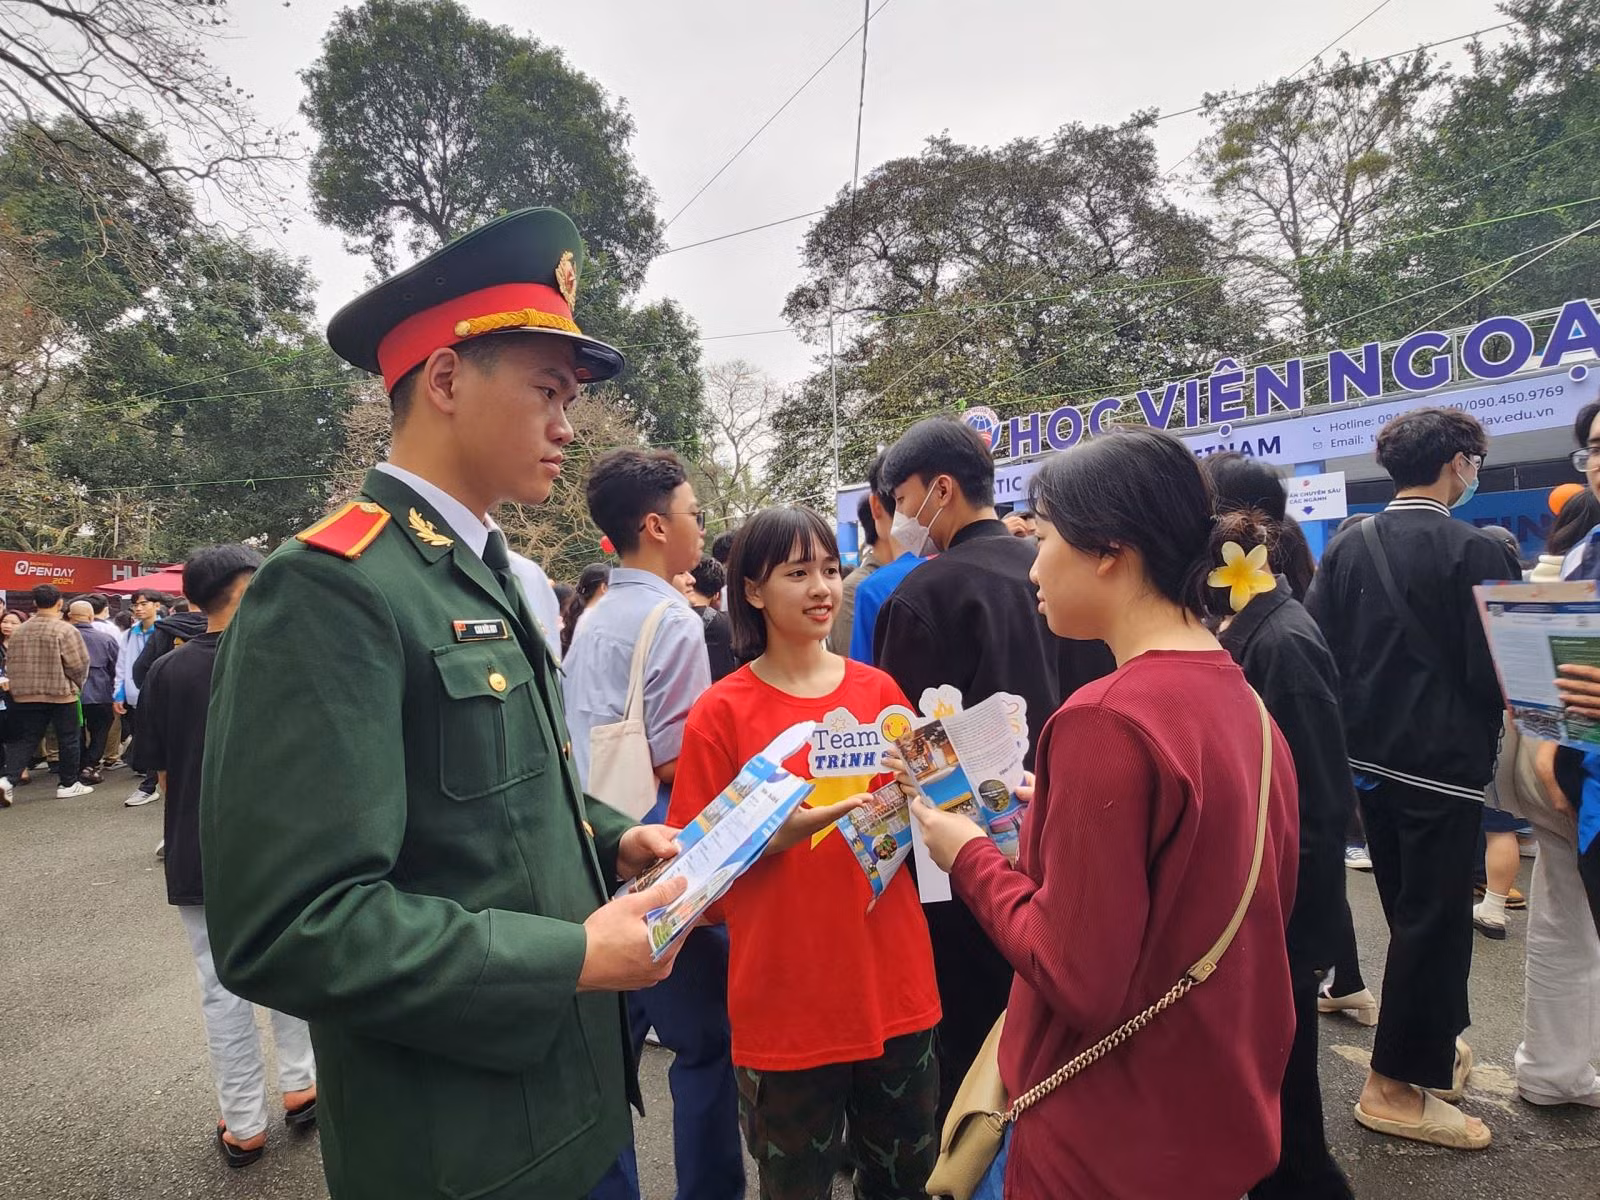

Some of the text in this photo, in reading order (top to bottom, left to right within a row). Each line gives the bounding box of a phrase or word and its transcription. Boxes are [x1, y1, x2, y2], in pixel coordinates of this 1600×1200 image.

[1135, 357, 1304, 438] VIỆN
[1330, 419, 1374, 432] Hotline:
[1331, 435, 1364, 448] Email:
[51, 577, 75, 585] 2024
[812, 729, 881, 751] Team
